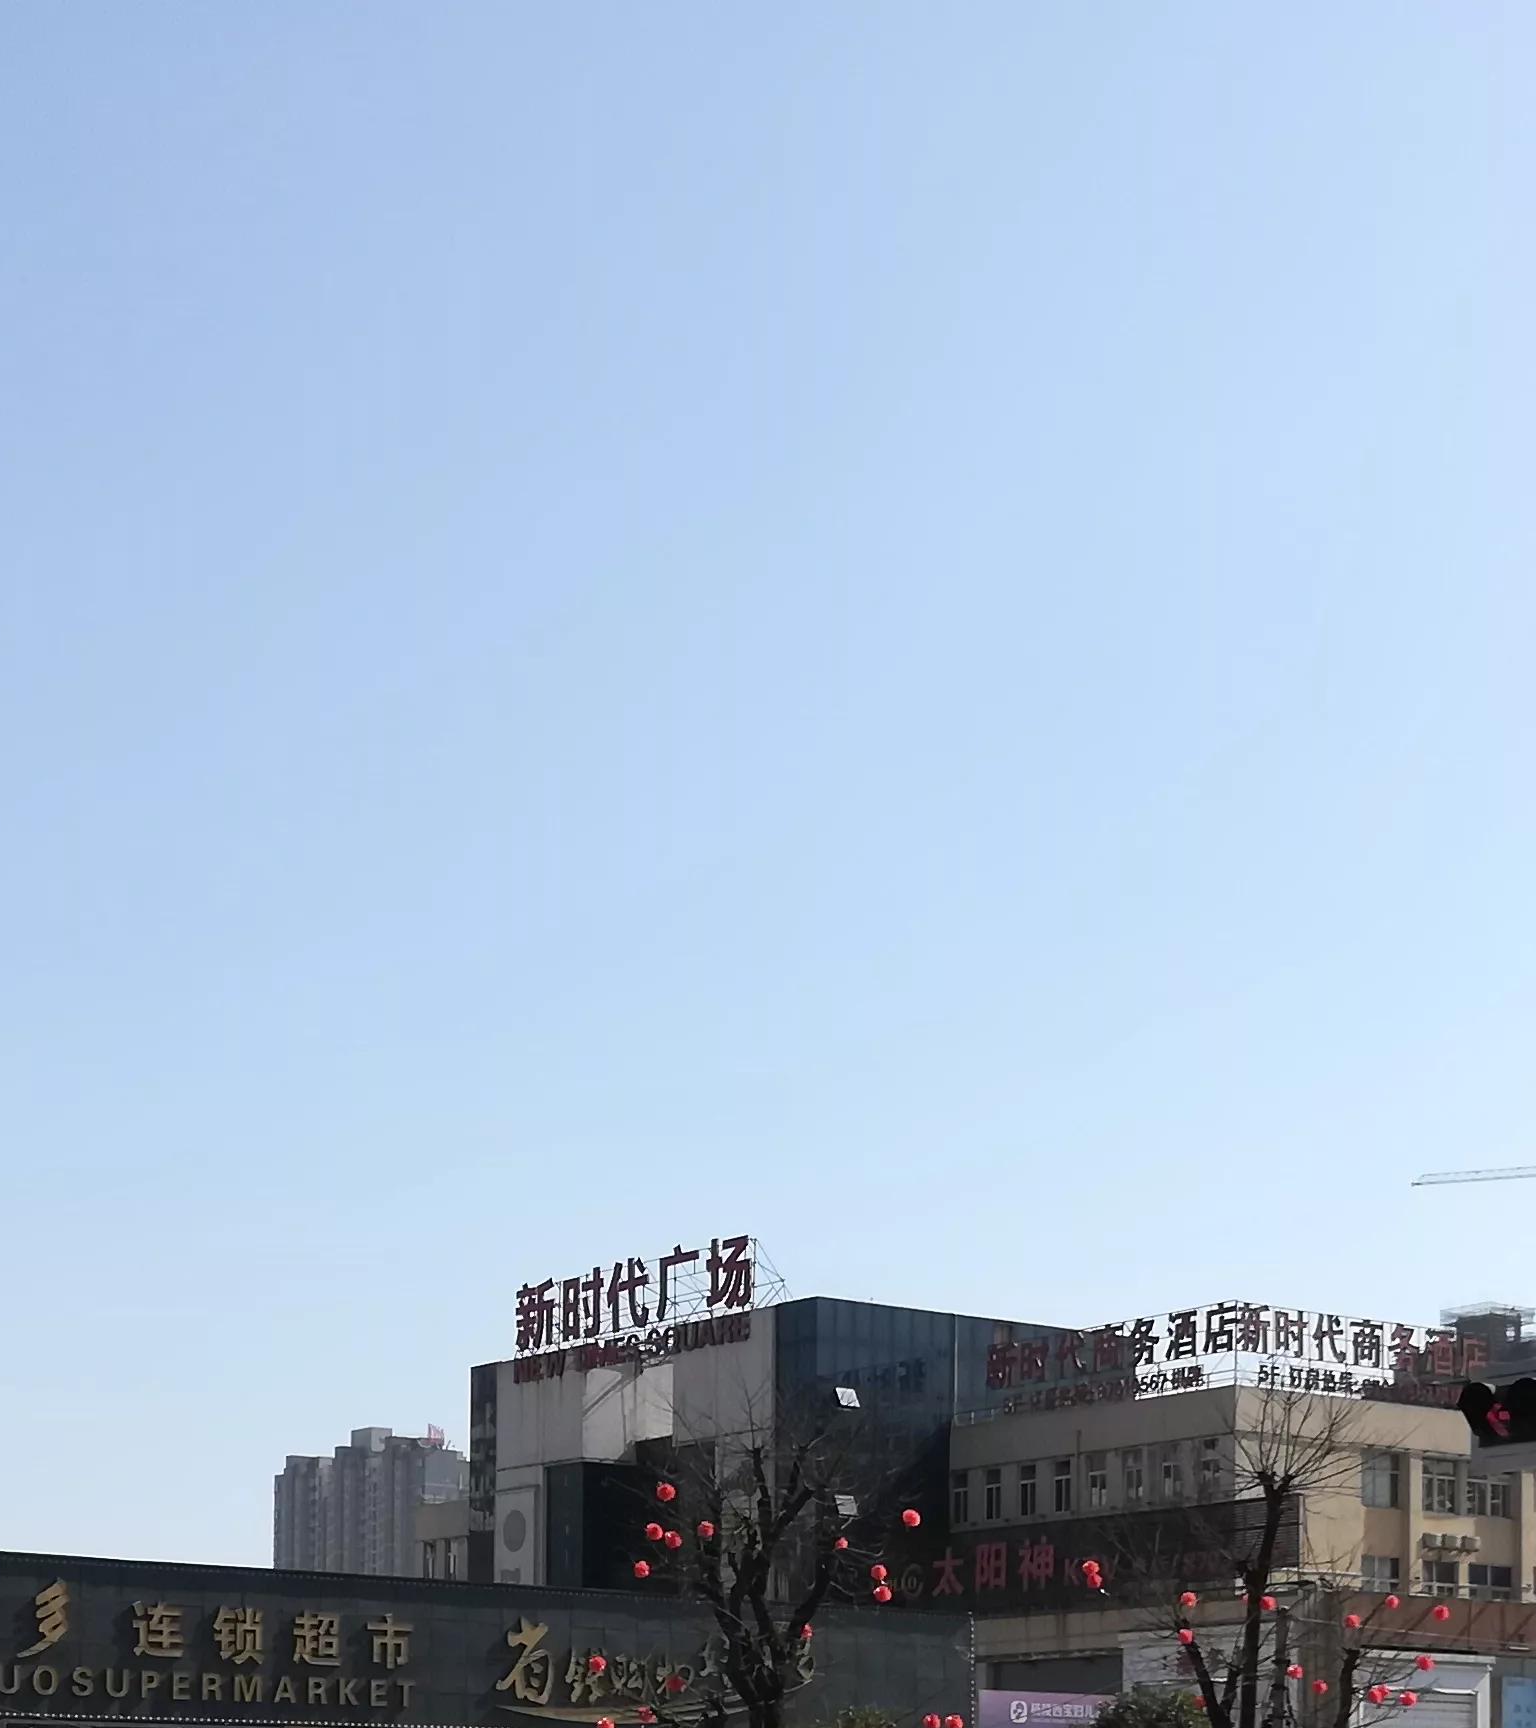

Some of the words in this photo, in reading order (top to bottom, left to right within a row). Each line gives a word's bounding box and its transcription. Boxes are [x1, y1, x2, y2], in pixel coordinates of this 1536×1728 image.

[515, 1235, 753, 1350] 新时代广场
[1236, 1302, 1490, 1377] 新时代商务酒店
[932, 1536, 1056, 1597] 太阳神
